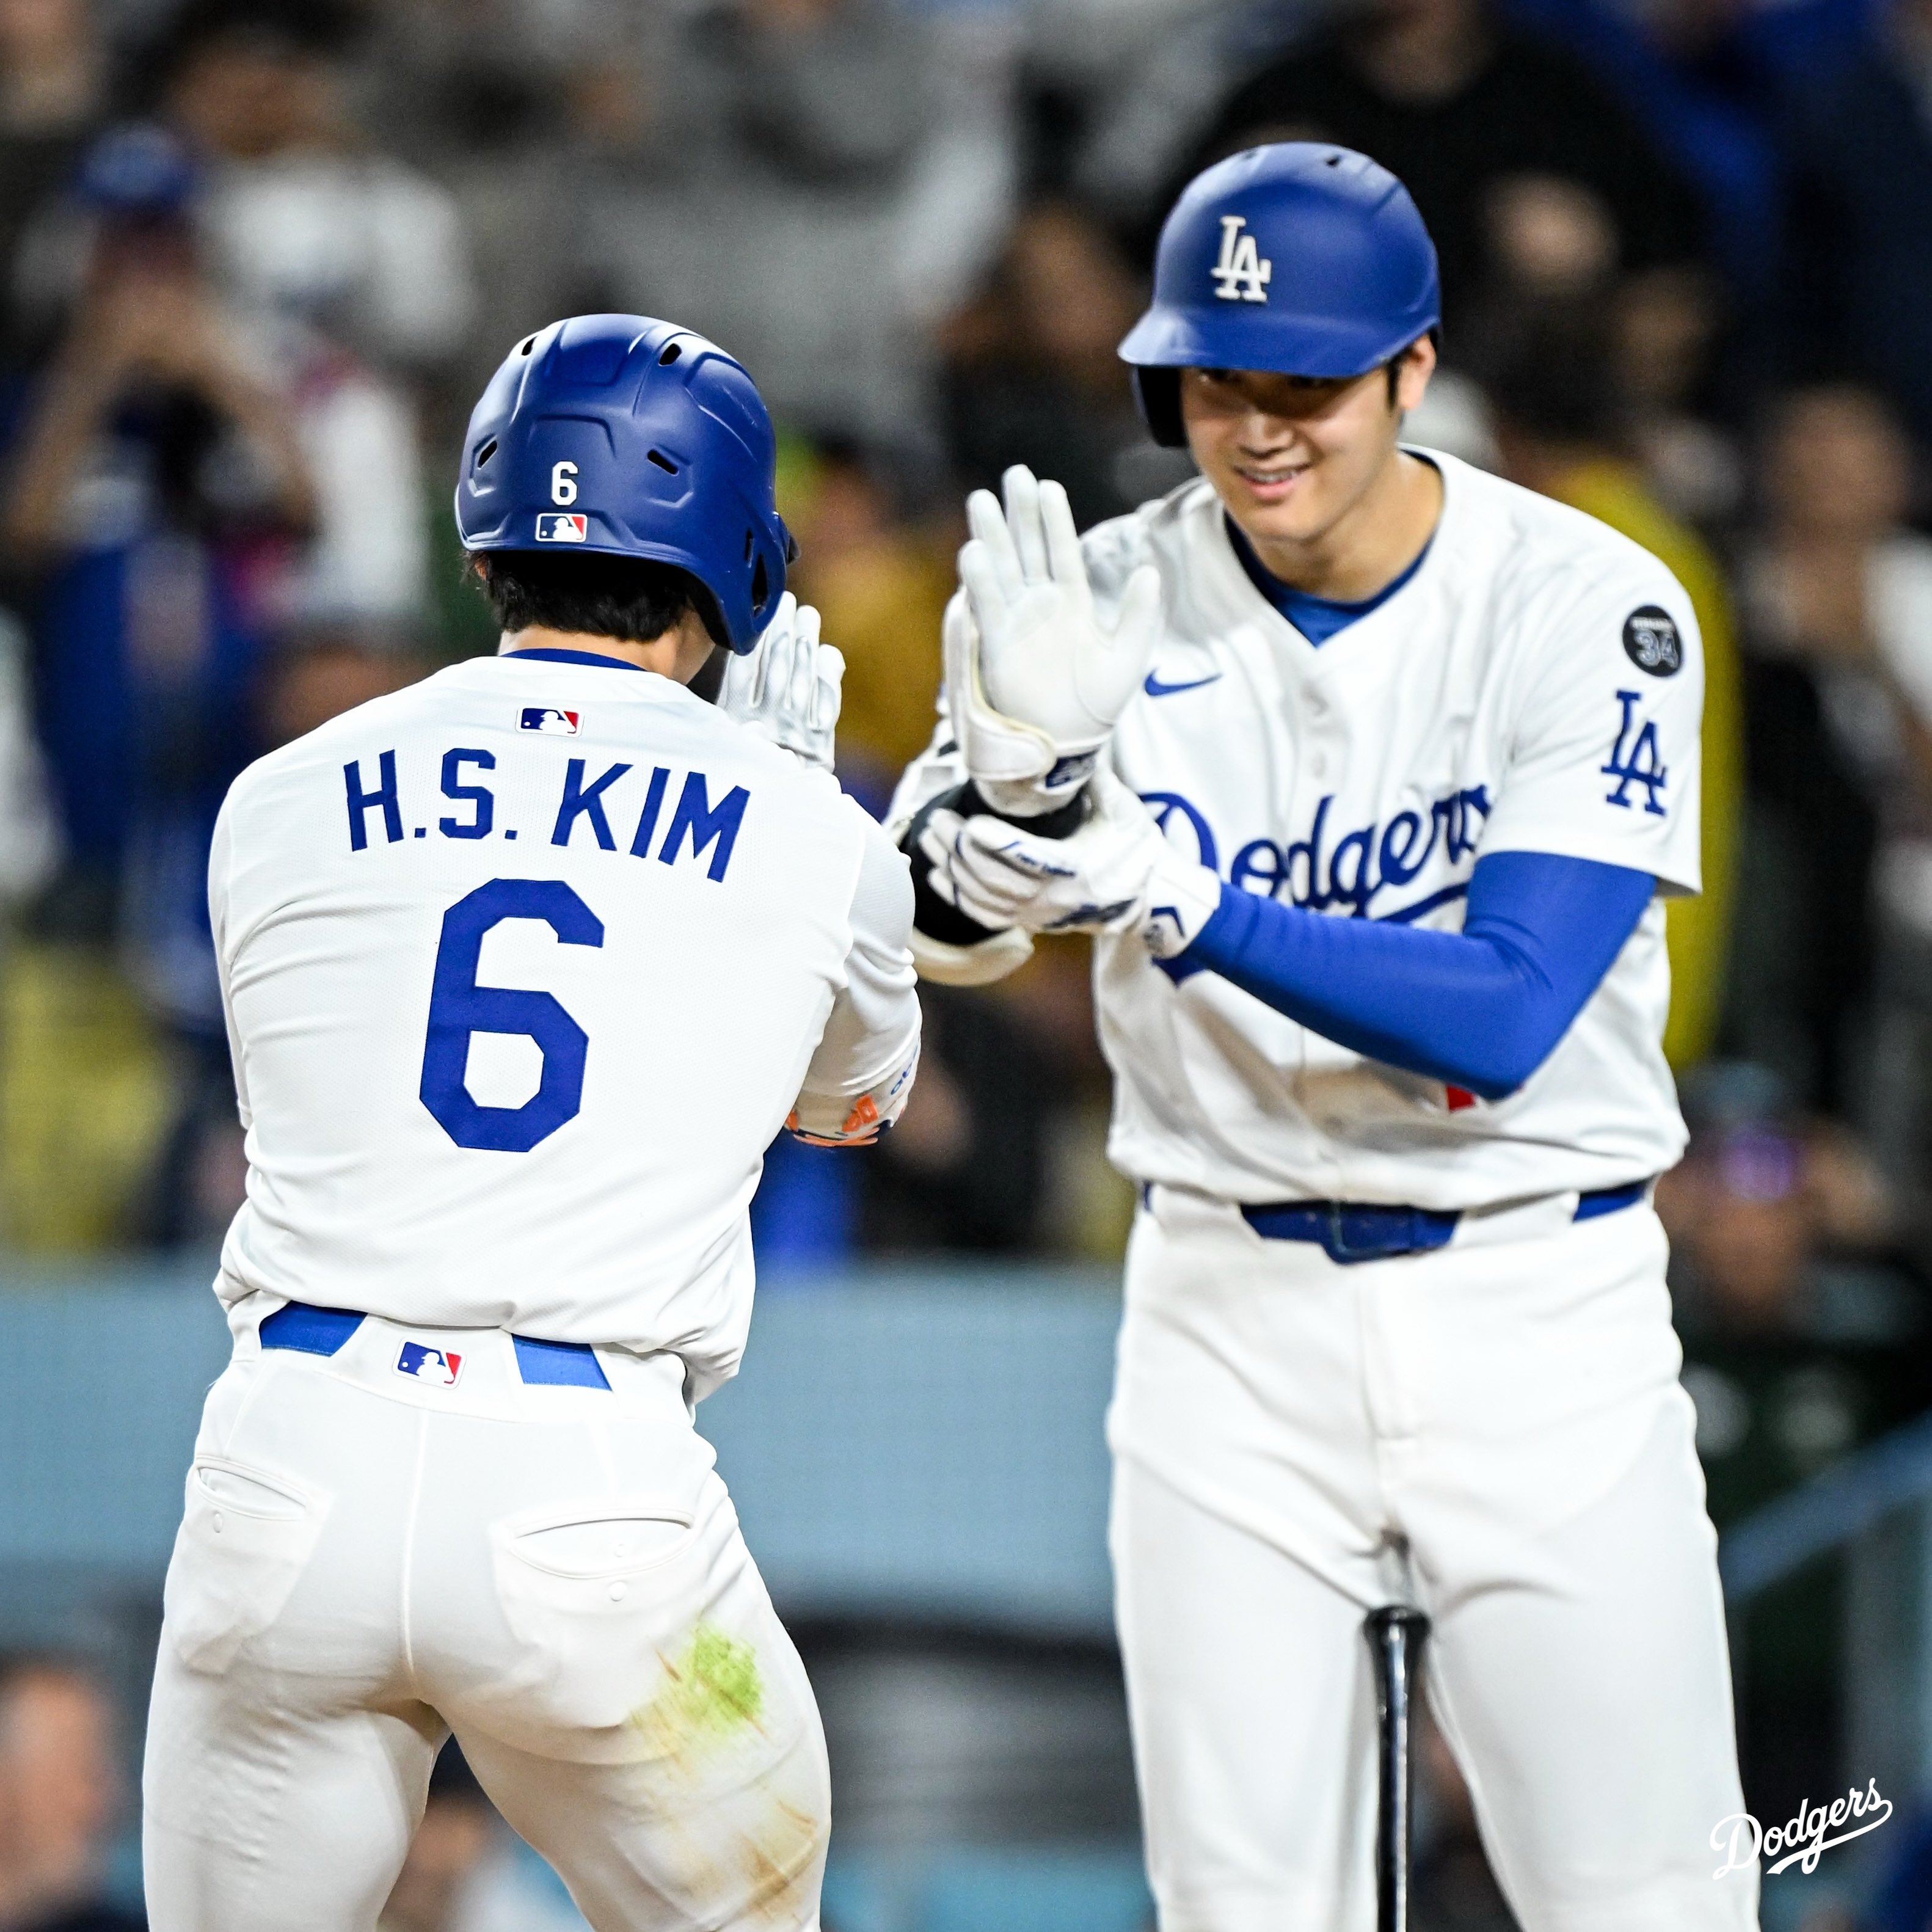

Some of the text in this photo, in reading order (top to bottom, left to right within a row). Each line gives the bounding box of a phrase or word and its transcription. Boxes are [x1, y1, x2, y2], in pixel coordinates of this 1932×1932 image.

[1210, 215, 1272, 303] LA
[551, 461, 578, 506] 6
[1633, 630, 1679, 668] 34
[1600, 688, 1667, 817] LA
[344, 748, 751, 883] H.S. KIM
[419, 878, 605, 1153] 6
